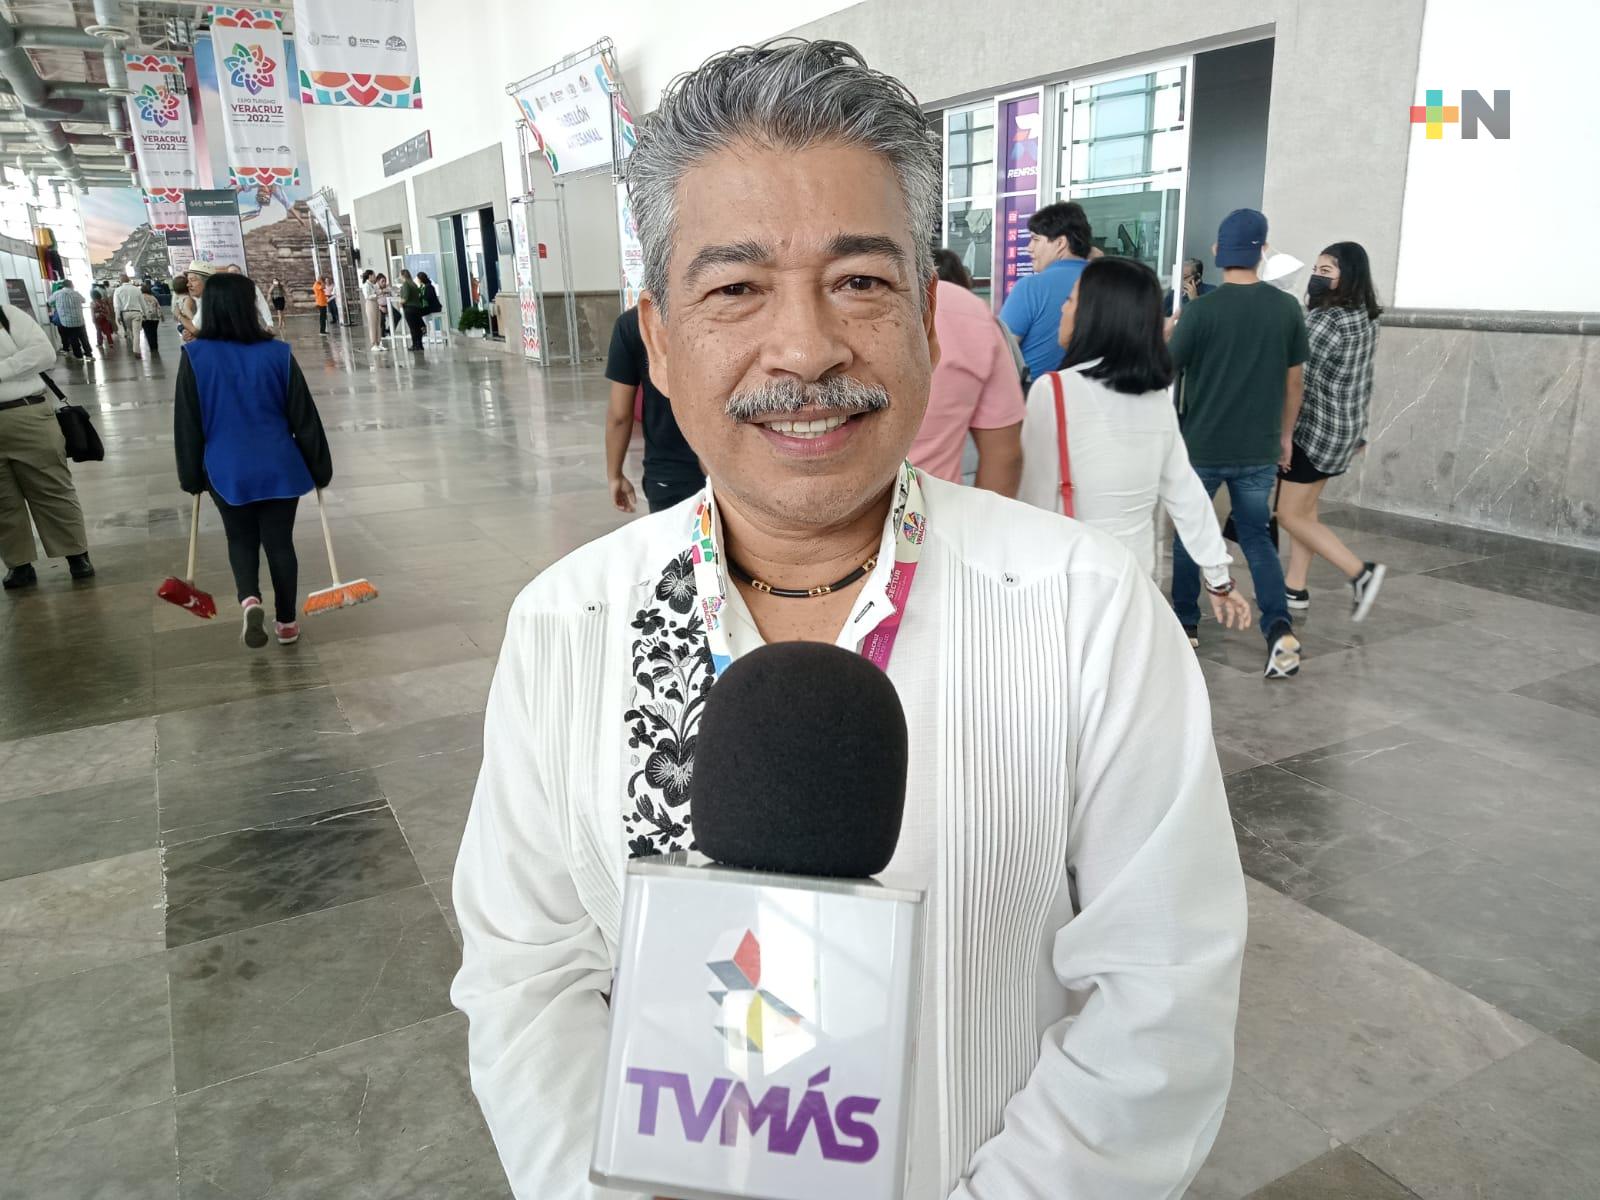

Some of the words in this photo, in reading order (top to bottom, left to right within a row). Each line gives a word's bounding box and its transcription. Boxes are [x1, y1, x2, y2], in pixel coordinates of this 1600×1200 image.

[231, 104, 284, 114] VERACRUZ
[247, 114, 271, 122] 2022
[142, 135, 188, 143] VERACRUZ
[887, 569, 903, 600] SECTUR
[702, 598, 713, 631] VERACRUZ
[626, 1065, 881, 1164] TVMÁS
